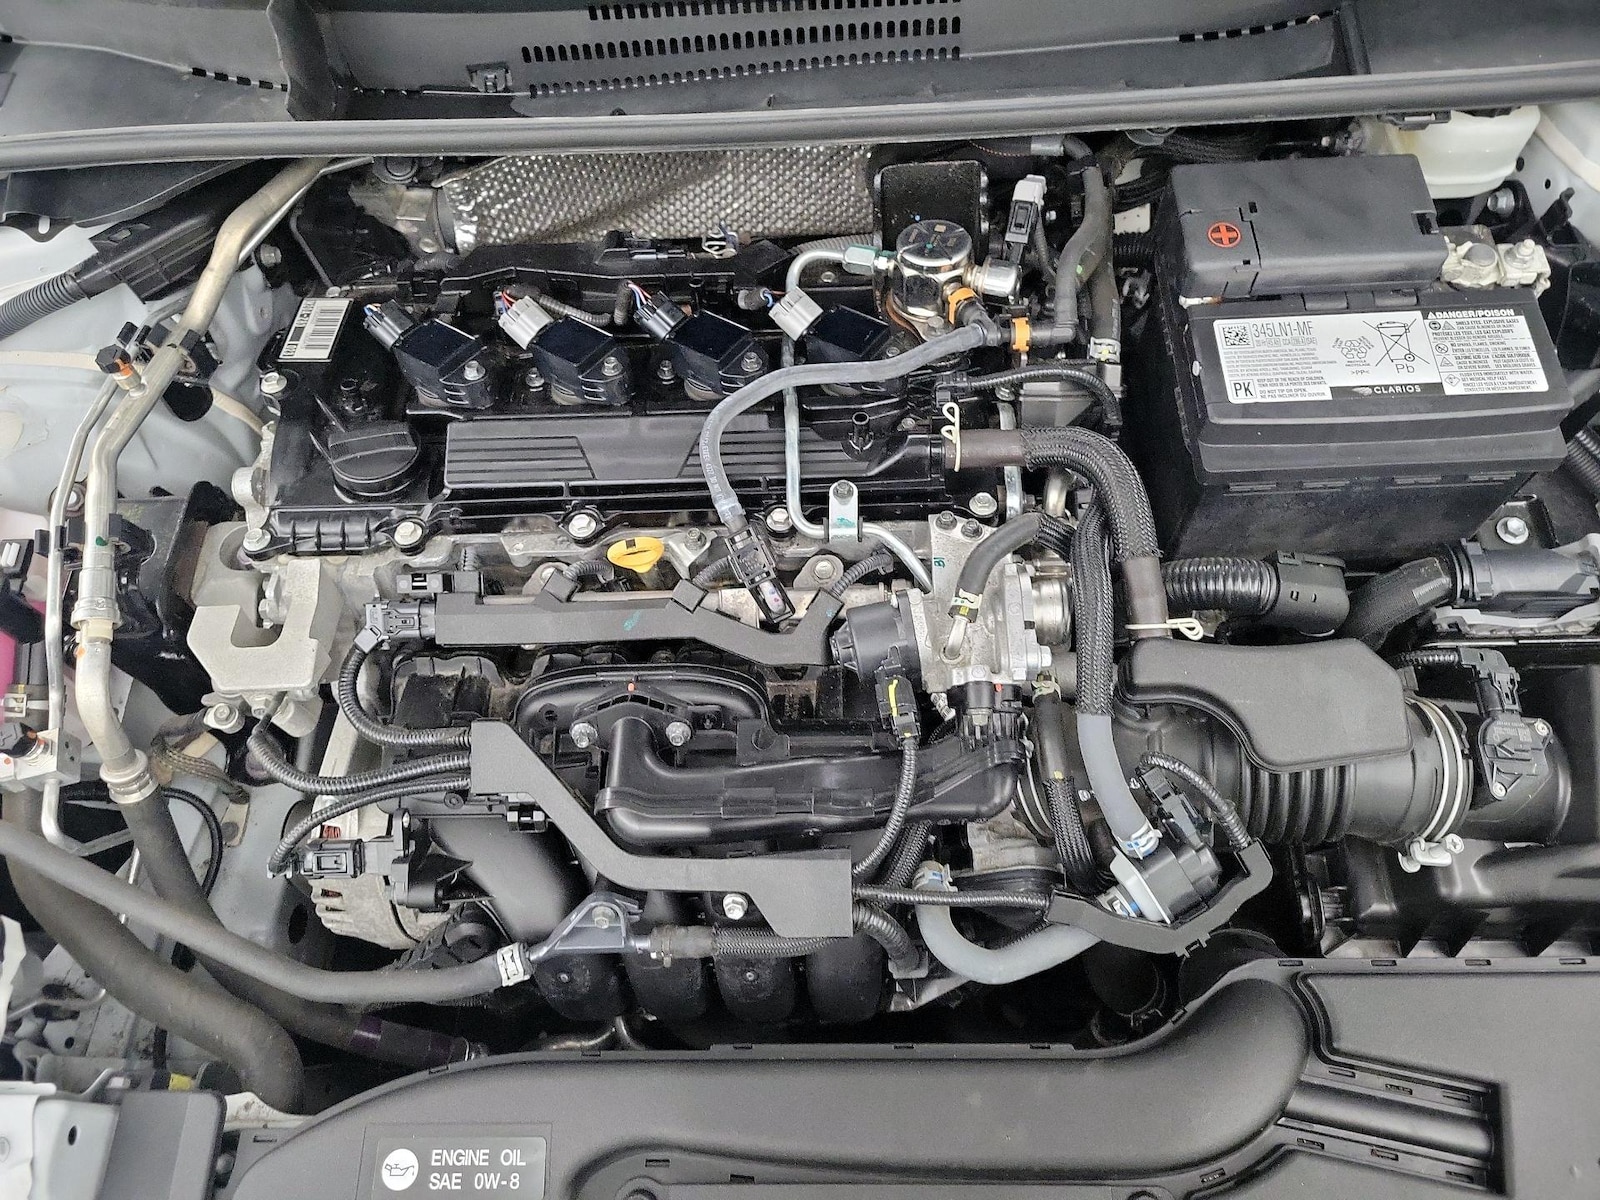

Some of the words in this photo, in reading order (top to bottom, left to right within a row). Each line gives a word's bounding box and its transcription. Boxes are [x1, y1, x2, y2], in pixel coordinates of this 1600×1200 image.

[1435, 308, 1515, 319] DANGER/POISON
[1251, 320, 1315, 338] 345LN1-MF
[1395, 363, 1415, 374] Pb
[1232, 381, 1253, 397] PK
[1373, 385, 1421, 394] CLARIOS
[431, 1149, 489, 1167] ENGINE
[500, 1149, 527, 1167] OIL
[429, 1172, 462, 1190] SAE
[474, 1172, 520, 1190] 0W-8
